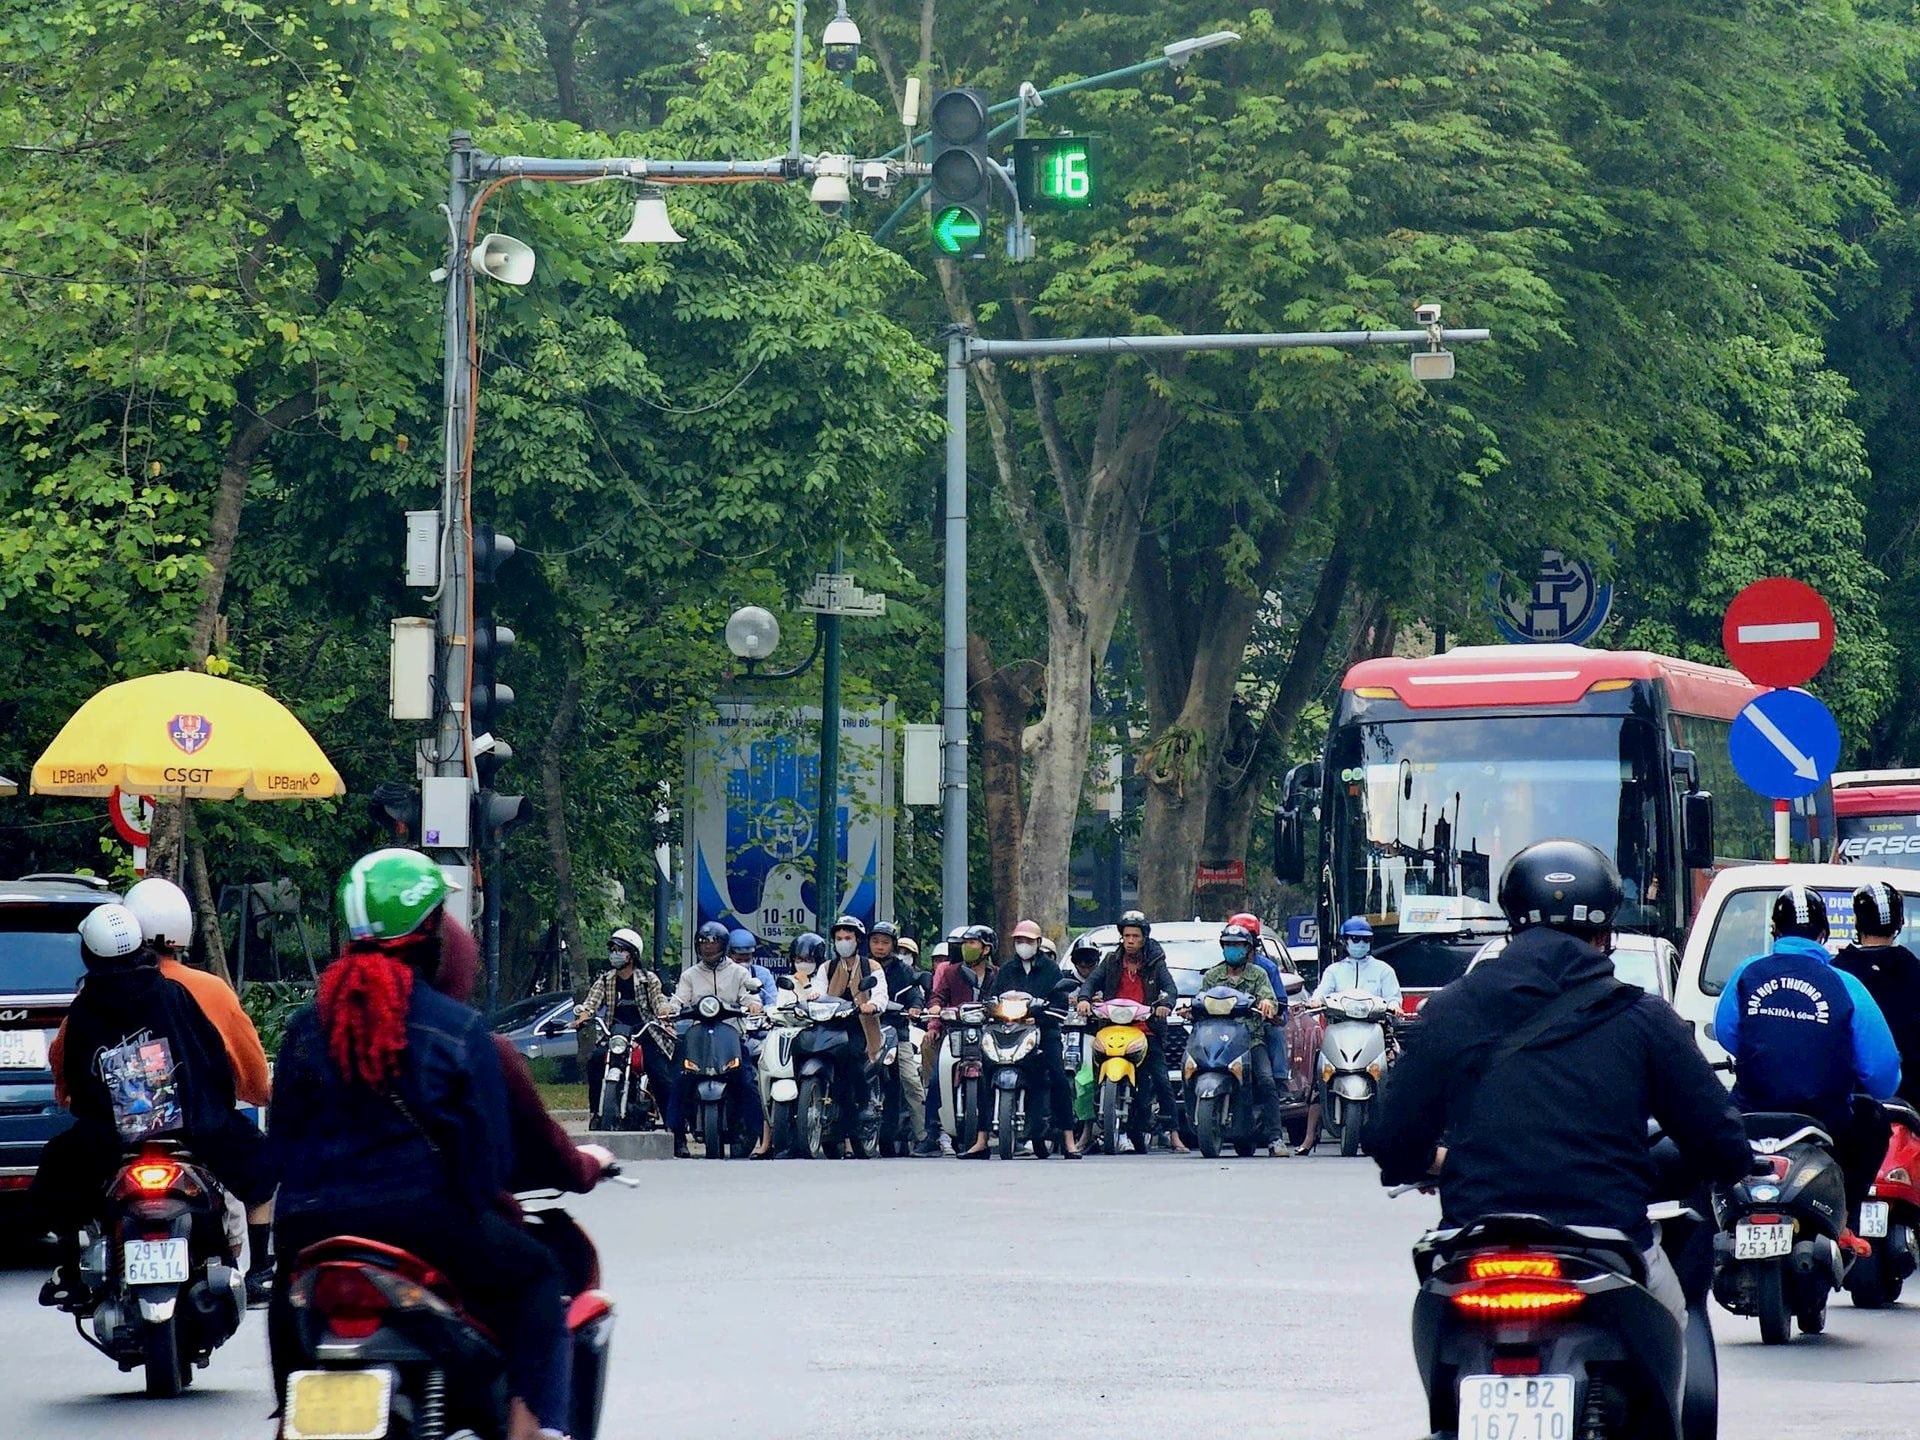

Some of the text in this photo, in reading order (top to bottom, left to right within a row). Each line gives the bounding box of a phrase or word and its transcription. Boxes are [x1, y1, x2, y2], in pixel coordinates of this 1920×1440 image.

[1055, 152, 1089, 198] 16
[173, 731, 207, 739] CSGT
[52, 768, 98, 784] LPBank
[163, 767, 213, 783] CSGT
[268, 775, 309, 790] LPBank
[1828, 897, 1854, 910] DỤN
[1747, 977, 1830, 1024] ĐẠI HỌC THƯƠNG MẠI
[1767, 1007, 1807, 1020] KHÓA 60
[1746, 1226, 1784, 1241] 15-AA
[134, 1242, 177, 1261] 29-V7
[1739, 1239, 1788, 1257] 253.12
[129, 1261, 183, 1280] 645.14
[1479, 1381, 1555, 1408] 89-B2
[1470, 1412, 1564, 1440] 167.10
